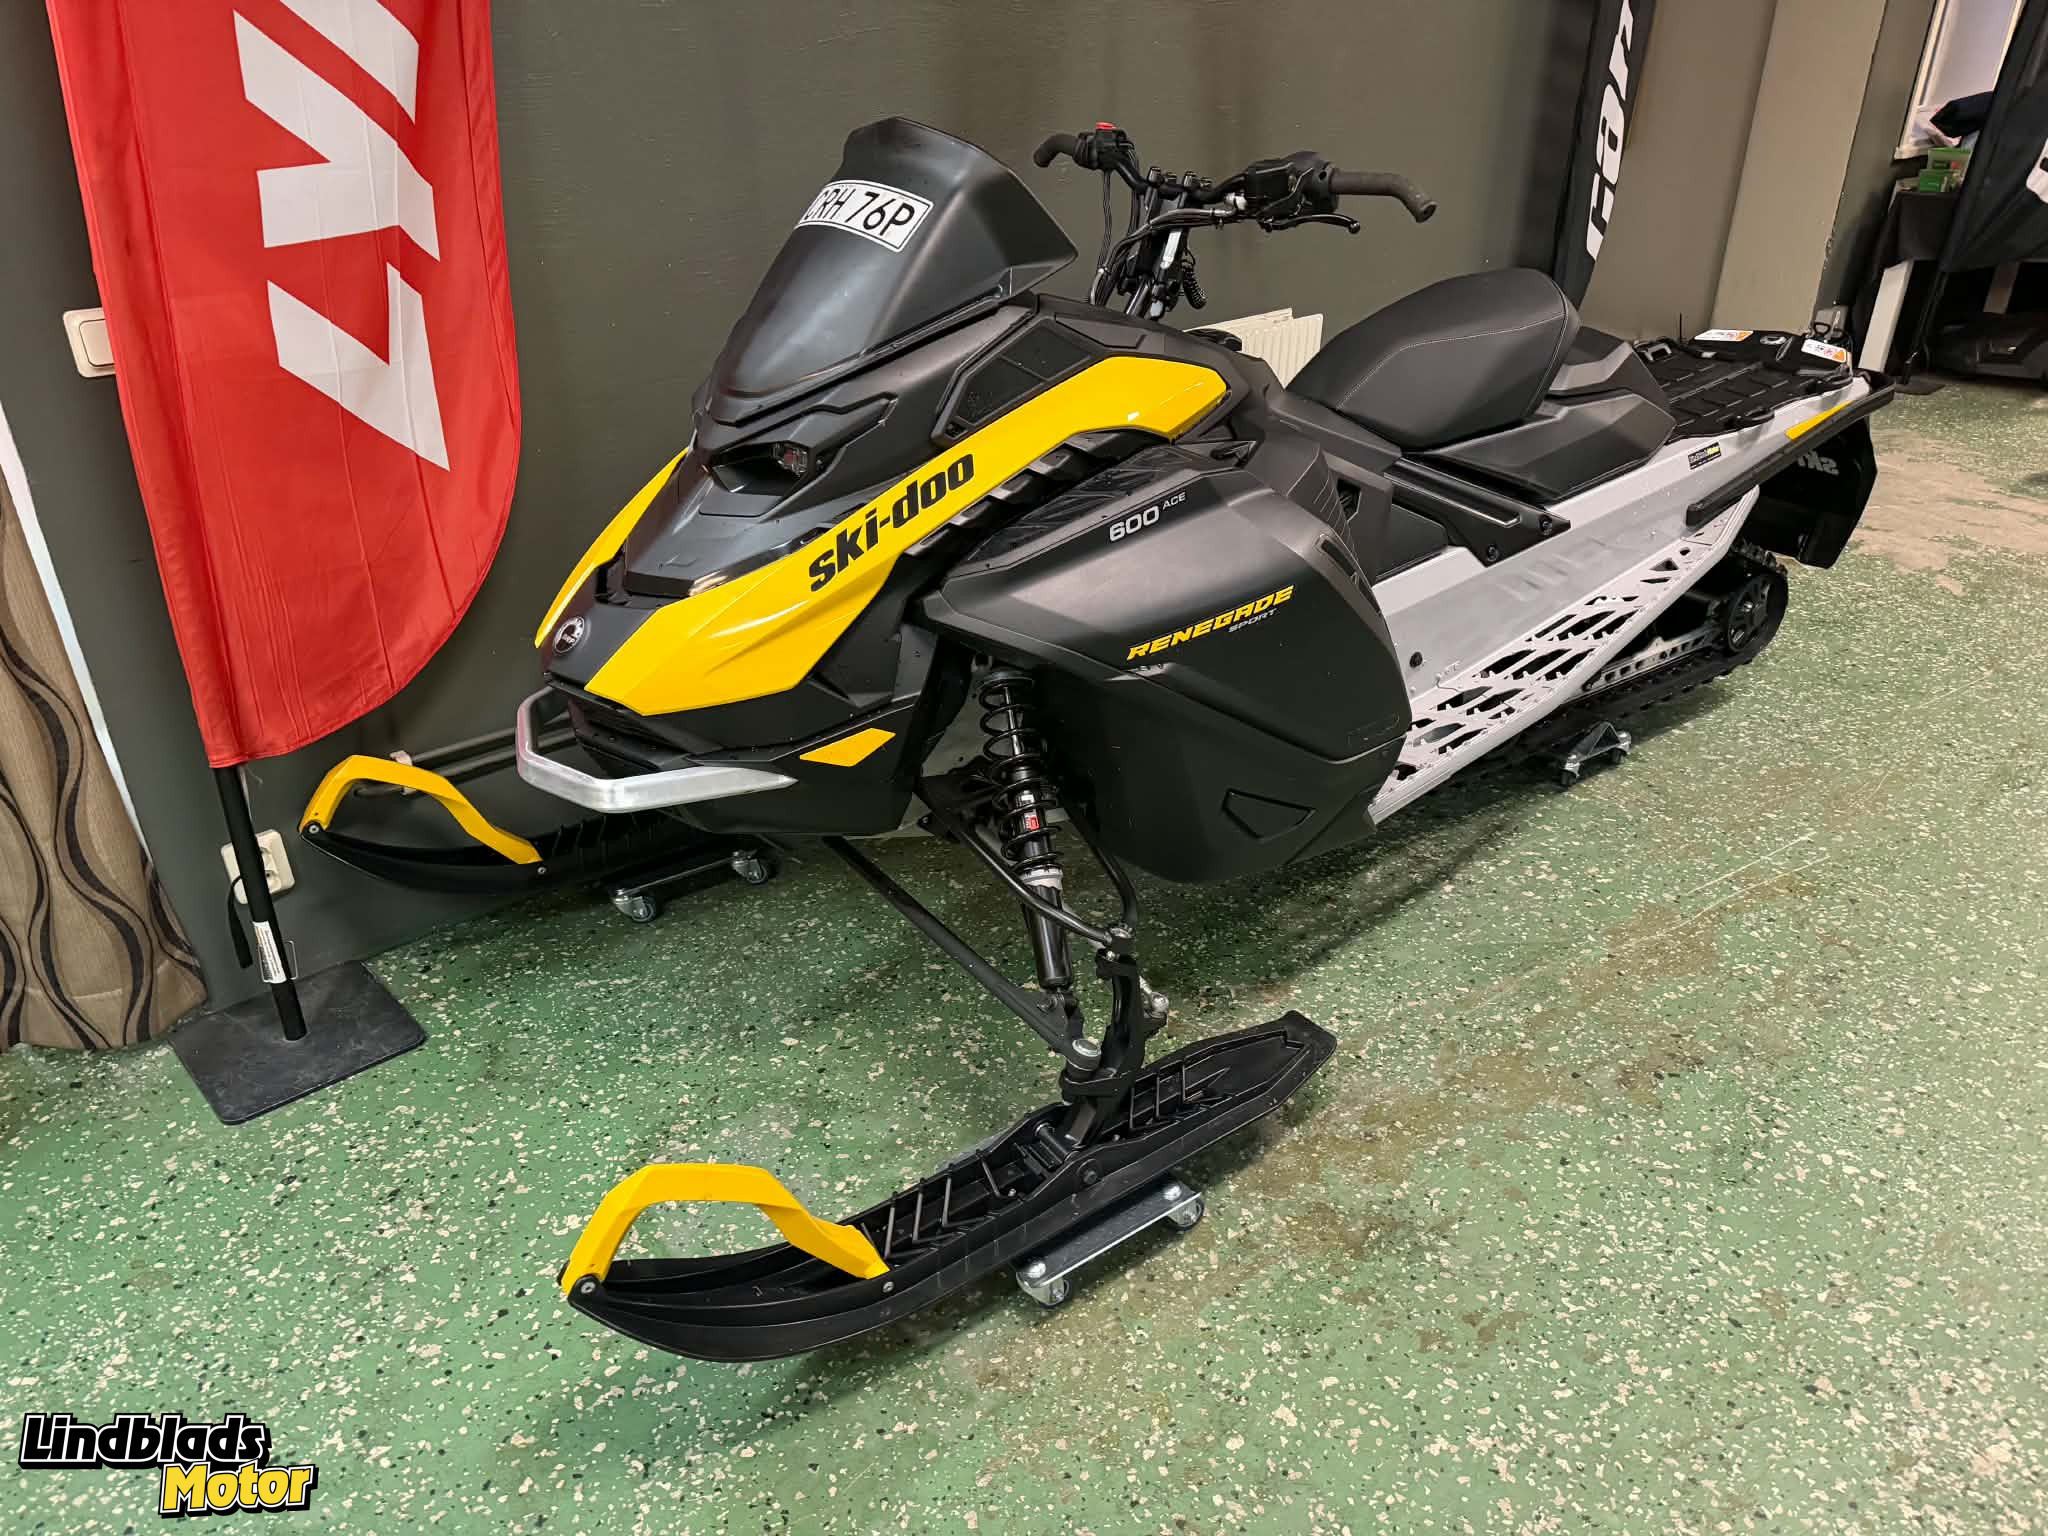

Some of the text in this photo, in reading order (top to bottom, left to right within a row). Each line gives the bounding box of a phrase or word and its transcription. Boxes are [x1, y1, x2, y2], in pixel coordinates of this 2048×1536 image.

[845, 191, 915, 236] 76P
[808, 453, 974, 592] ski-doo
[1109, 492, 1187, 542] 600 ACE
[1126, 585, 1294, 661] RENEGADE
[1228, 607, 1277, 633] SPORT
